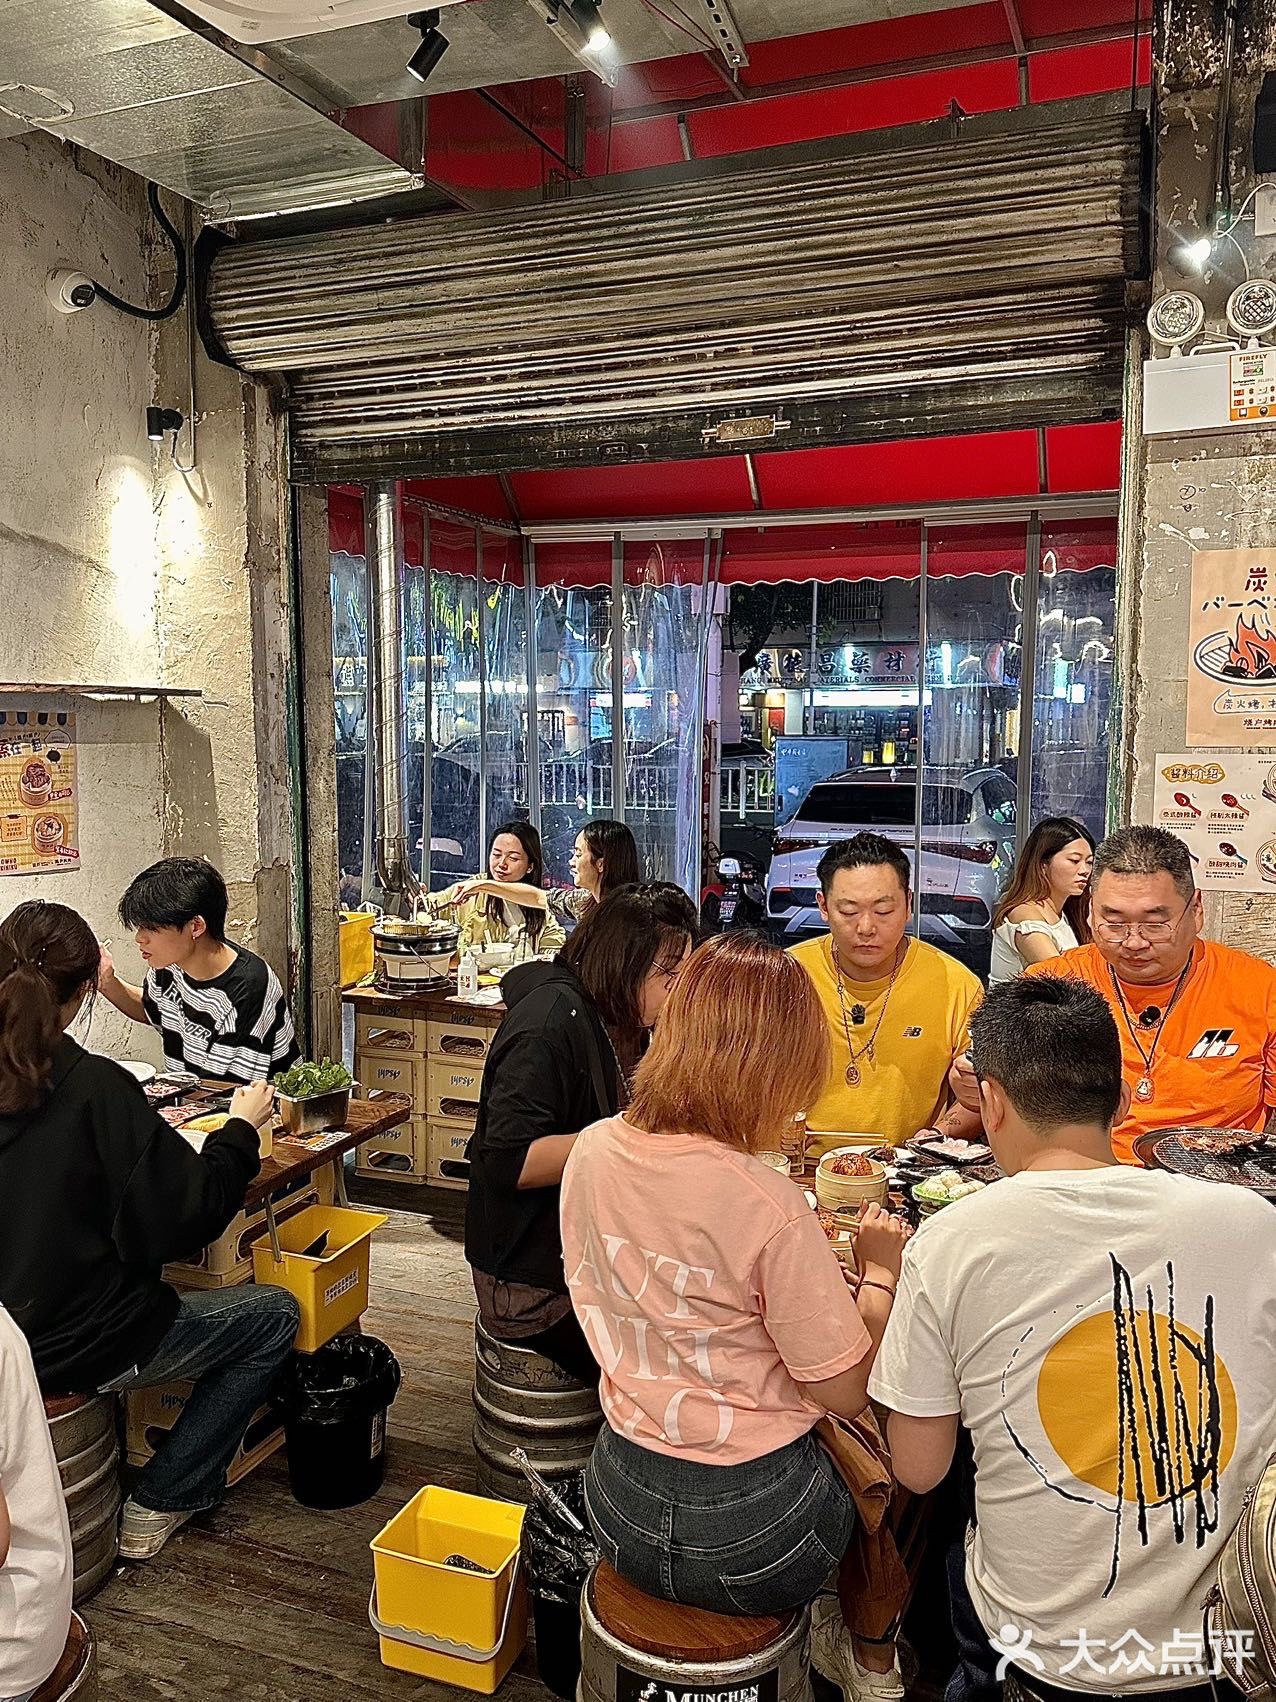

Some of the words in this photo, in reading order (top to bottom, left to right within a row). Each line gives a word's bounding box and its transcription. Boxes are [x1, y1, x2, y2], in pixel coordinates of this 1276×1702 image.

[1239, 353, 1267, 361] FIREFLY
[1245, 566, 1276, 592] 炭
[1202, 596, 1276, 611] バーベ
[450, 1013, 475, 1024] Asahi
[377, 1068, 401, 1081] Asahi
[450, 1075, 475, 1087] Asahi
[450, 1136, 468, 1148] sahi
